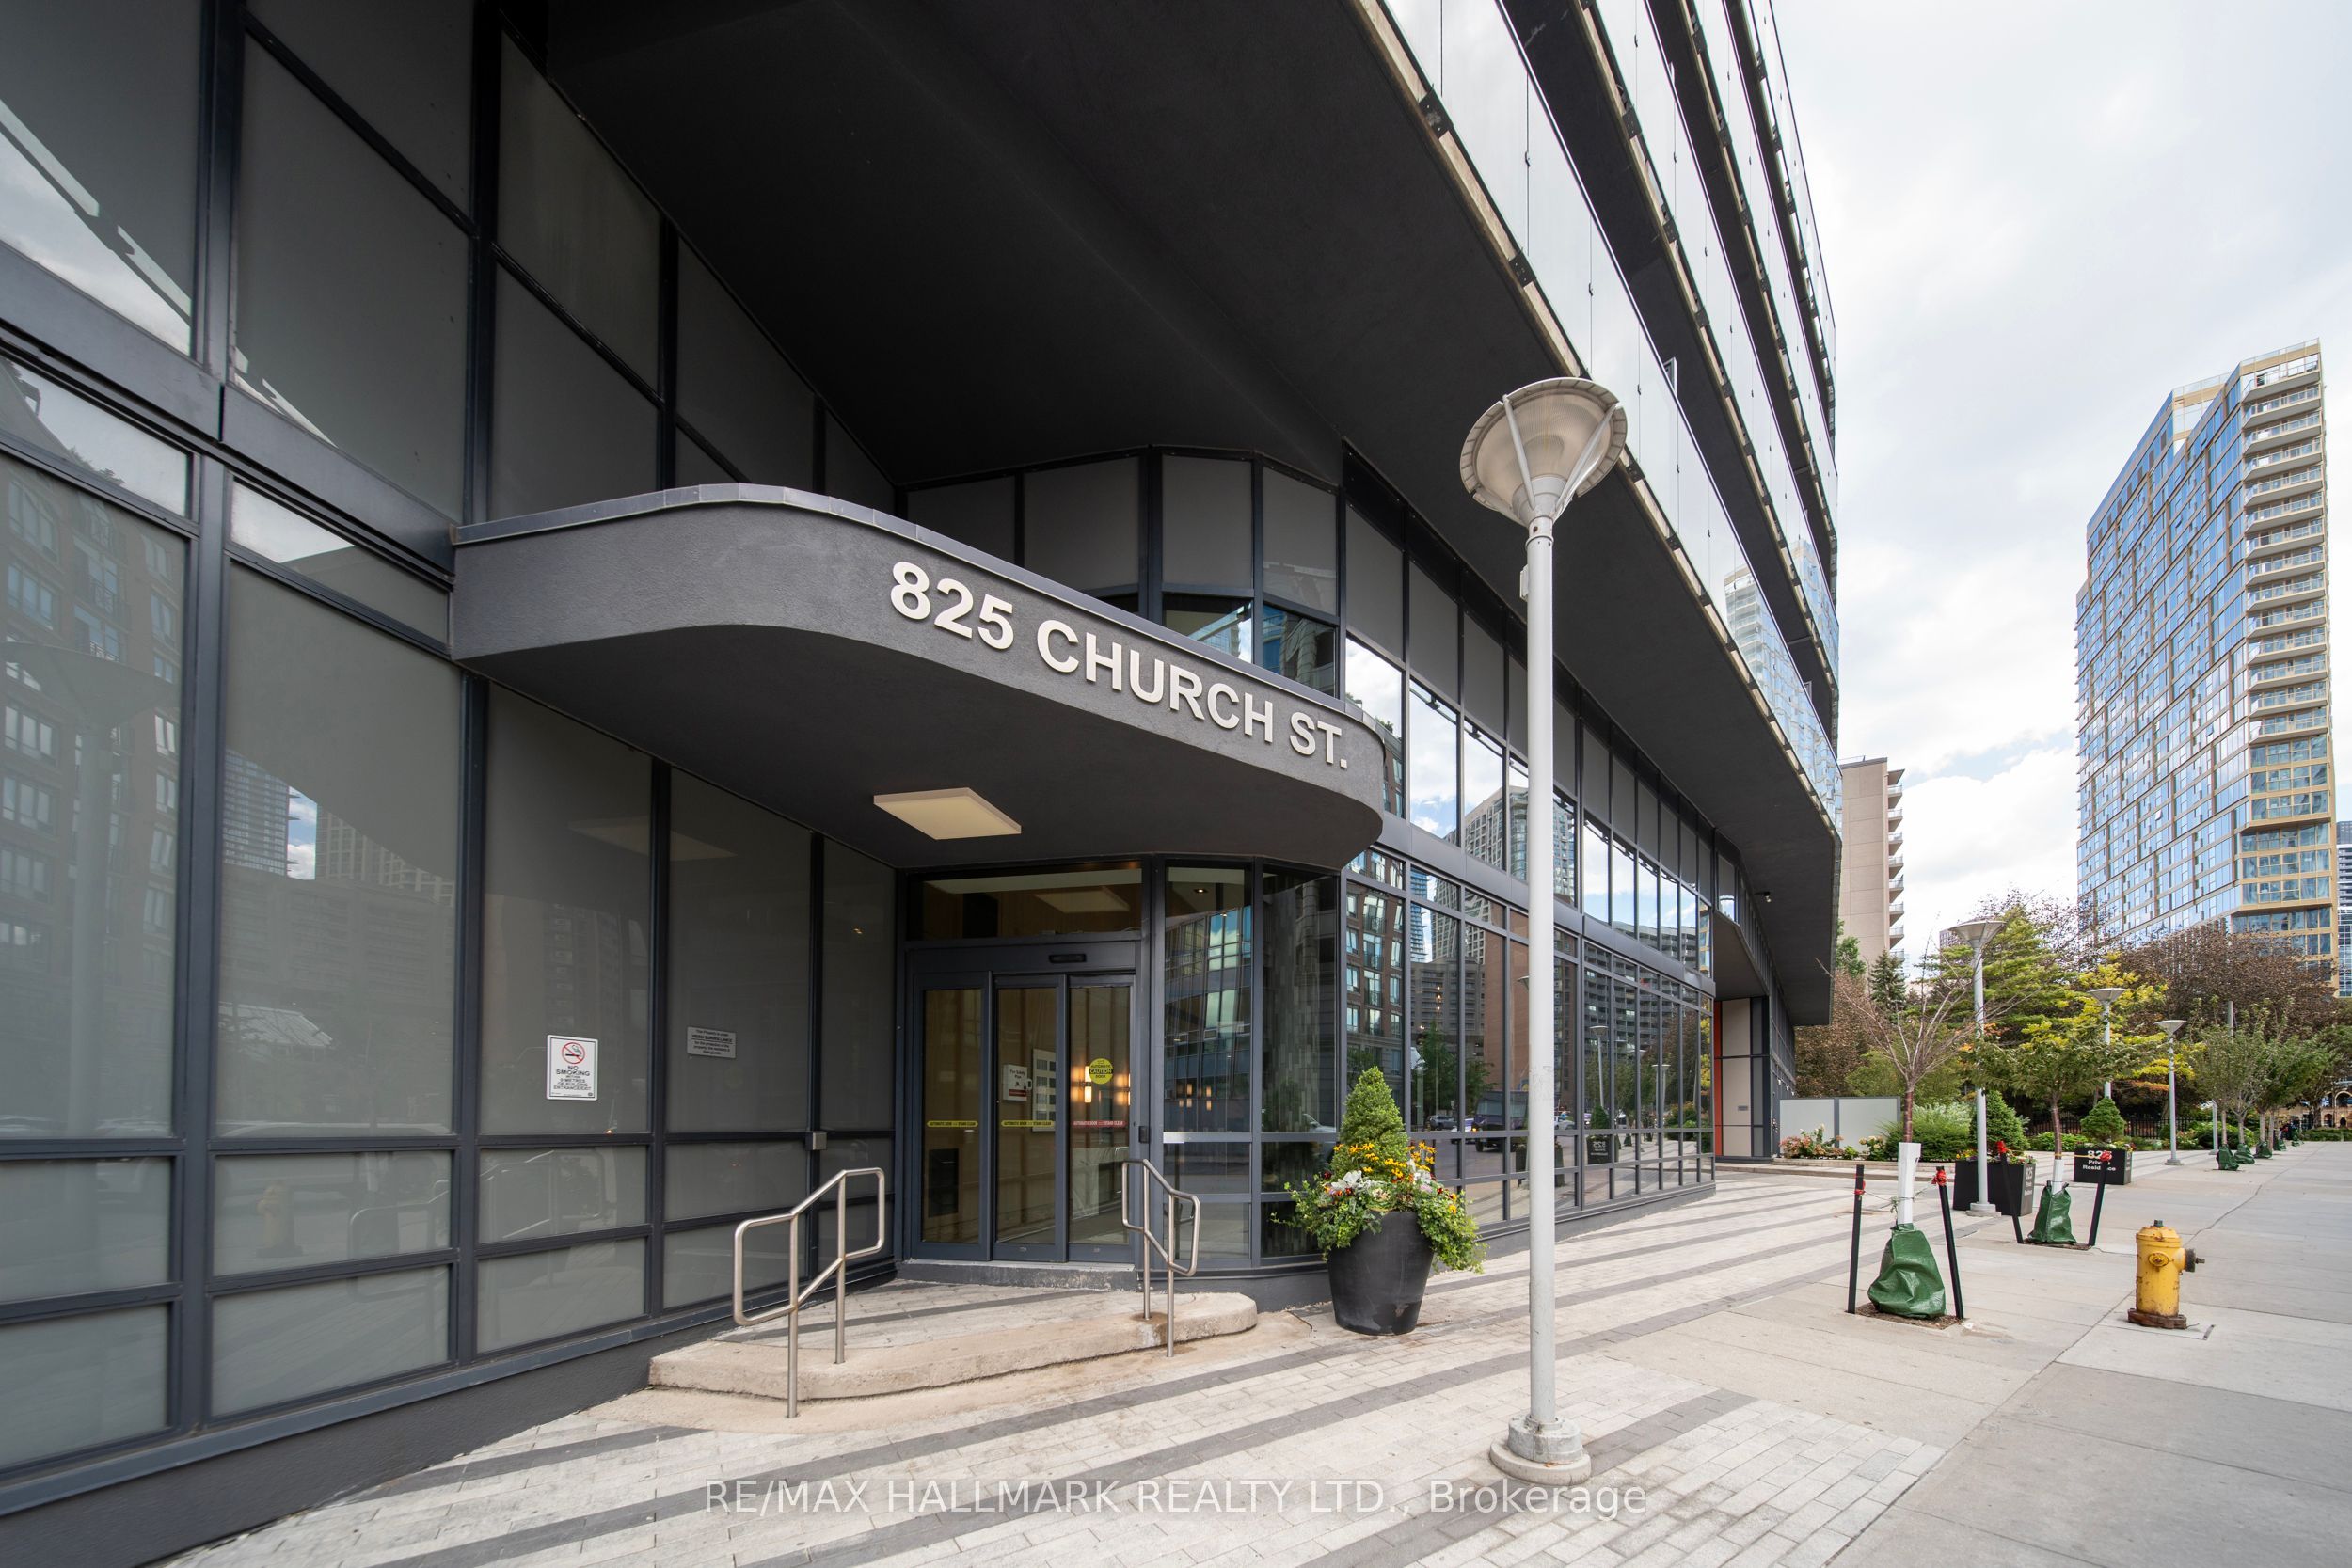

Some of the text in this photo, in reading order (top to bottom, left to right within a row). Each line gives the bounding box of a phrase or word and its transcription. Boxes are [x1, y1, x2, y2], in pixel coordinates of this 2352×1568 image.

[890, 561, 1348, 768] 825 CHURCH ST.
[556, 1069, 591, 1077] SMOKING
